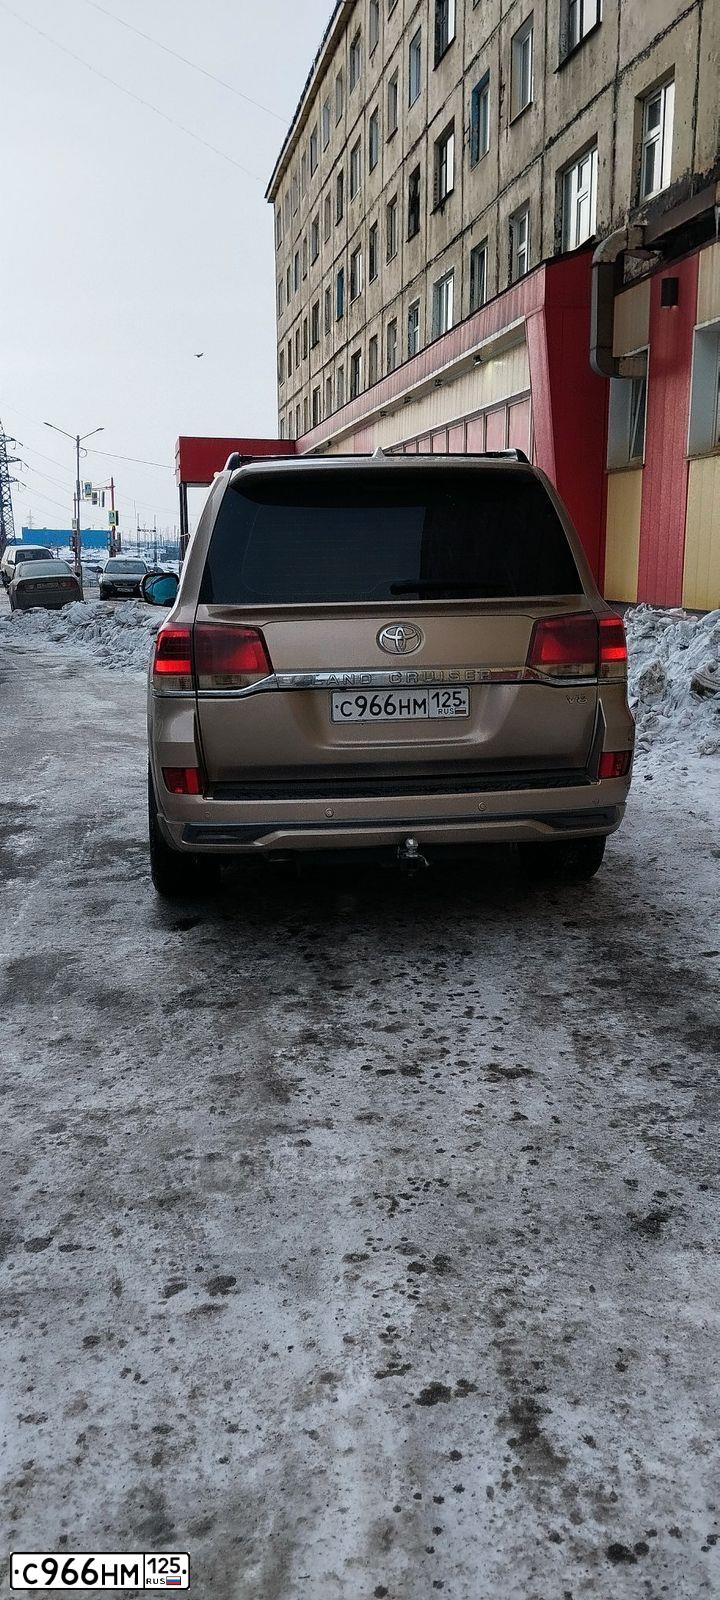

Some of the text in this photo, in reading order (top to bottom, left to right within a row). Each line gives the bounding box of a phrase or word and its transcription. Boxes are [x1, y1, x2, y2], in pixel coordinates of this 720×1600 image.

[313, 670, 492, 686] LAND CRUISER
[431, 691, 463, 708] 125
[437, 707, 454, 715] RUS
